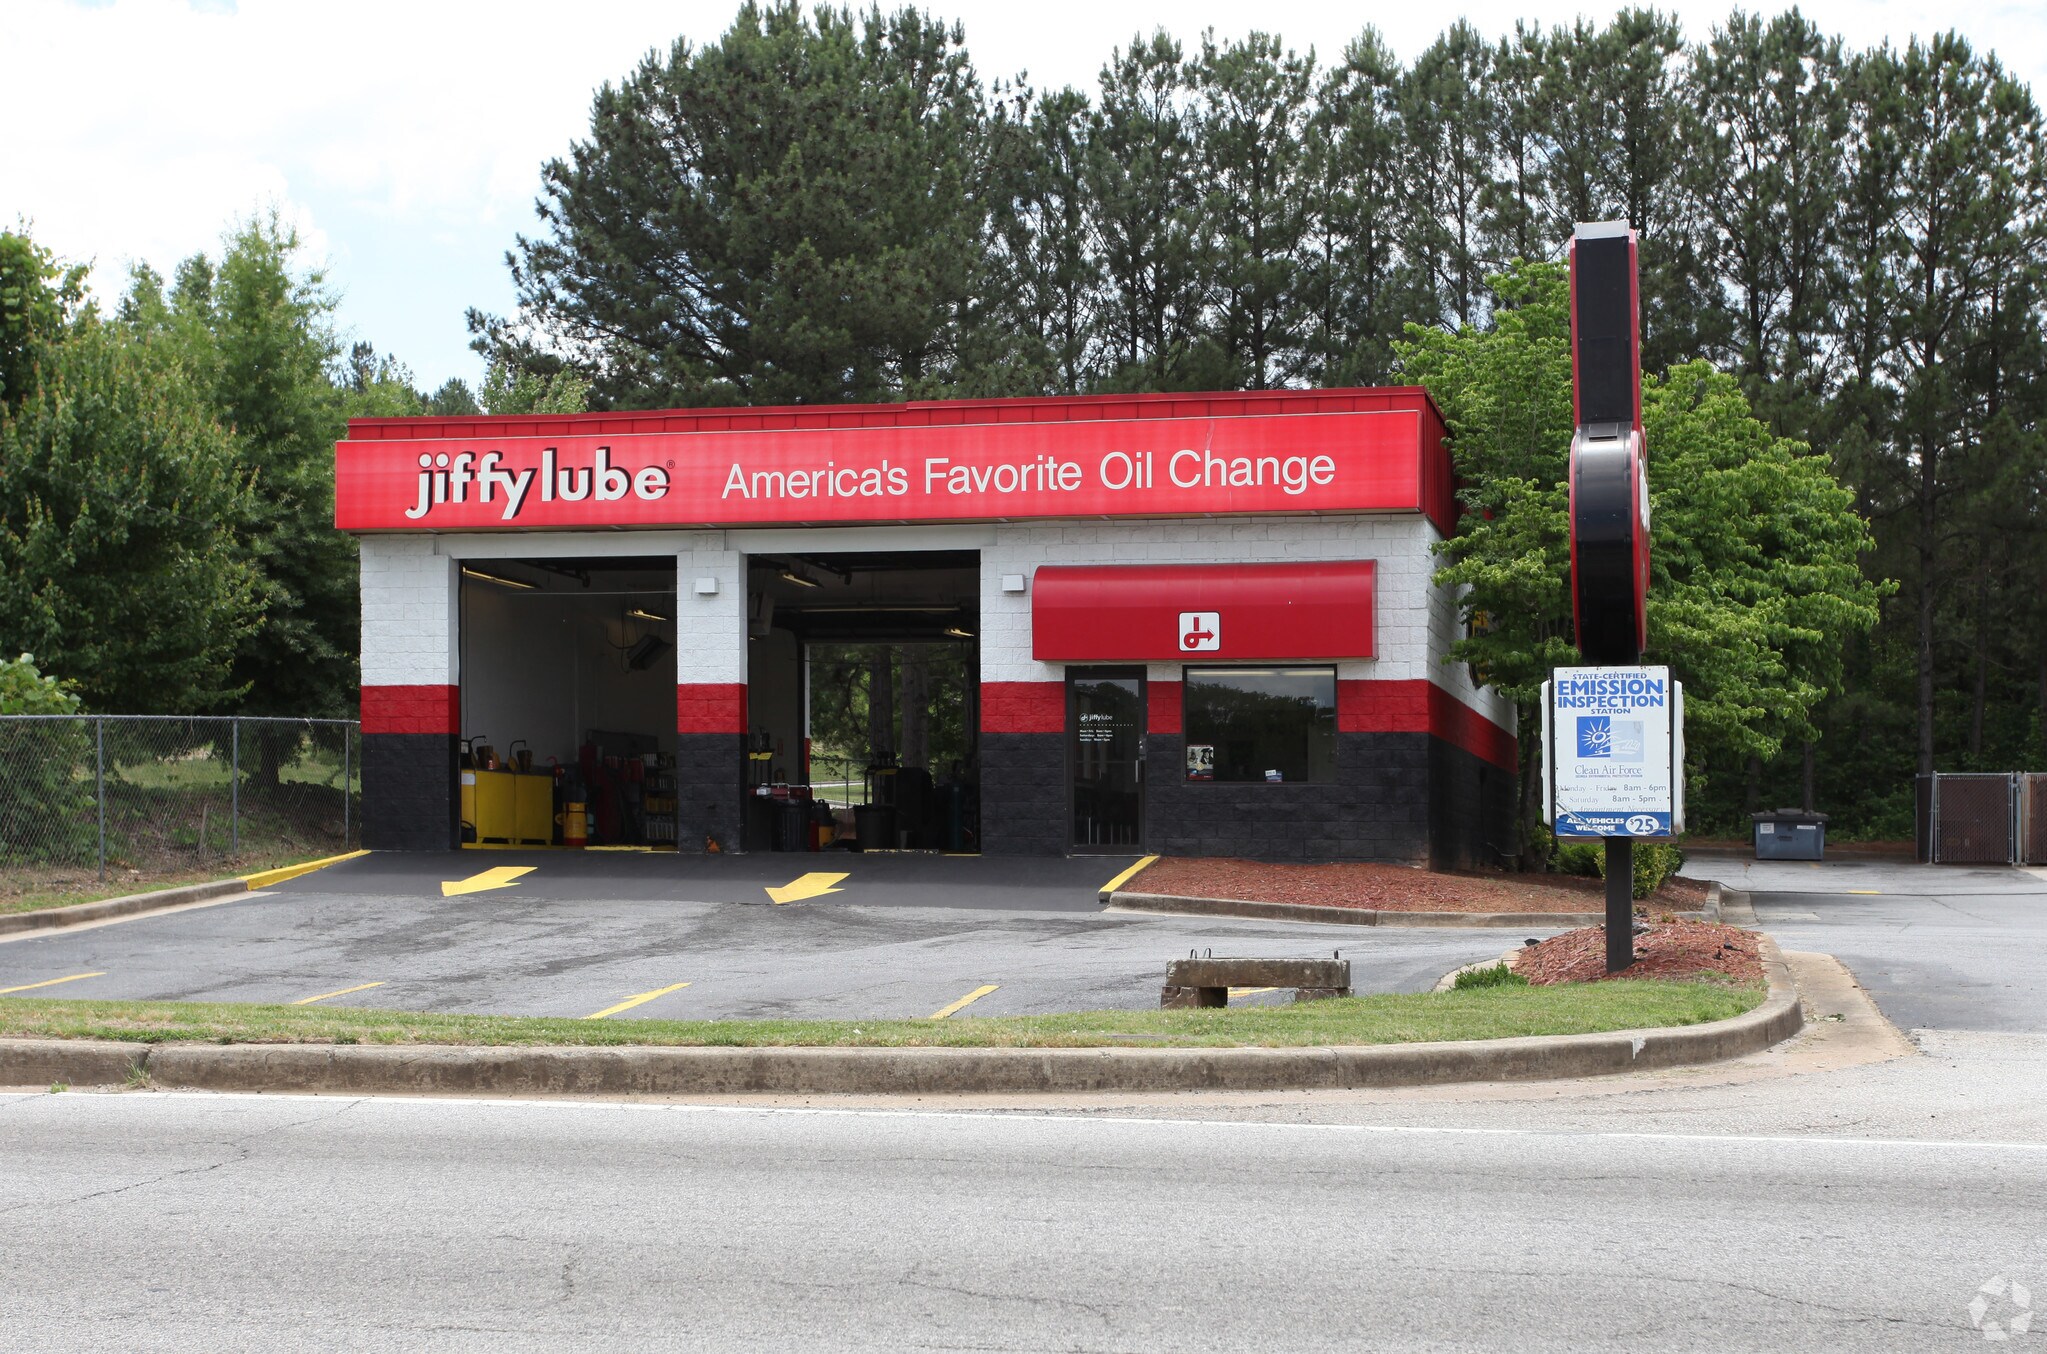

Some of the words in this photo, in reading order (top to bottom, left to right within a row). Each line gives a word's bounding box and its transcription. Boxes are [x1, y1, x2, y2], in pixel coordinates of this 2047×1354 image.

[721, 459, 908, 499] America's
[925, 454, 1082, 494] Favorite
[1099, 451, 1153, 490] Oil
[1169, 449, 1336, 495] Change
[1572, 672, 1647, 680] STATE-CERTIFIED
[1558, 679, 1664, 695] EMISSION
[1558, 695, 1664, 708] INSPECTION
[1574, 765, 1599, 774] Clean
[1602, 765, 1616, 774] Air
[1619, 765, 1642, 774] Force
[1648, 784, 1667, 792] 6pm
[1569, 796, 1600, 804] Saturday
[1638, 795, 1656, 803] 5pm
